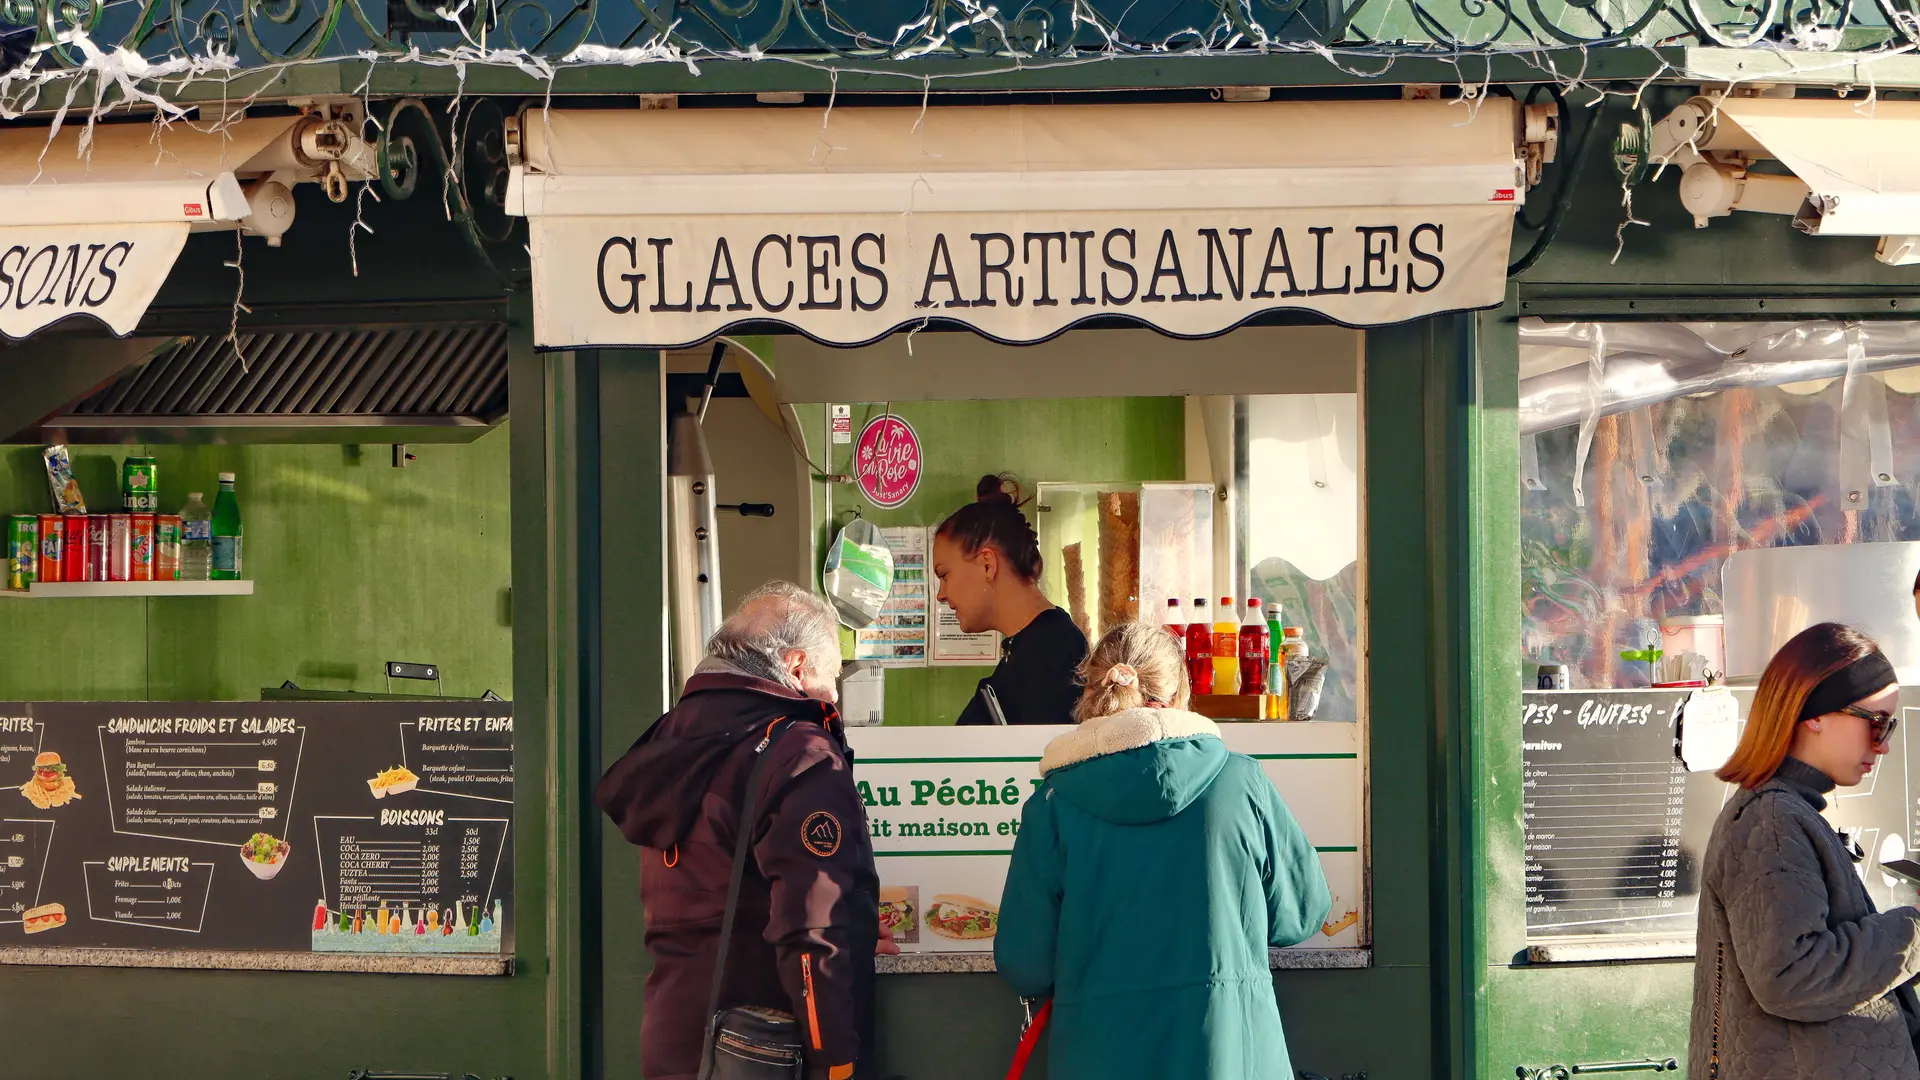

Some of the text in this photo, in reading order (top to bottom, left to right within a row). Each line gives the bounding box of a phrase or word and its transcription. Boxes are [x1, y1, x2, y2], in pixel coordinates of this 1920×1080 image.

[597, 223, 1445, 315] GLACES ARTISANALES
[876, 458, 907, 487] Rose
[1577, 699, 1652, 729] GAUFRES
[107, 717, 296, 734] SANDWICHS FROIDS ET SALADES
[418, 717, 461, 732] FRITES
[464, 717, 483, 731] ET
[422, 744, 447, 752] Barquette
[422, 765, 448, 773] Barquette
[1669, 776, 1686, 784] 3.00€
[857, 780, 901, 806] Au
[911, 777, 1019, 806] Péché
[1668, 786, 1685, 795] 3.00€
[1667, 797, 1684, 805] 3.00€
[380, 808, 445, 827] BOISSONS
[1665, 818, 1682, 826] 3.50€
[898, 818, 990, 837] maison
[997, 818, 1020, 836] et
[425, 828, 479, 836] 33cl 50cl
[1664, 828, 1681, 836] 3.50€
[340, 836, 480, 845] EAU 1,50€
[1663, 839, 1680, 847] 3.50€
[422, 845, 440, 853] 2,00€
[461, 845, 479, 853] 2,50€
[1661, 849, 1679, 857] 4.00€
[422, 853, 440, 861] 2,00€
[461, 853, 478, 861] 2,50€
[107, 856, 189, 873] SUPPLEMENTS
[421, 861, 440, 869] 2,00€
[460, 861, 478, 869] 2,50€
[340, 869, 478, 878] FUZTEA 2,00€ 2,50€
[1660, 870, 1677, 878] 4.00€
[421, 878, 439, 886] 2,00€
[1659, 880, 1676, 888] 4.50€
[422, 886, 439, 894] 2,00€
[1658, 890, 1675, 898] 4.50€
[166, 897, 182, 905] 1,00€
[340, 894, 350, 902] Eau
[461, 894, 478, 903] 2,00€
[166, 912, 182, 920] 2,00€
